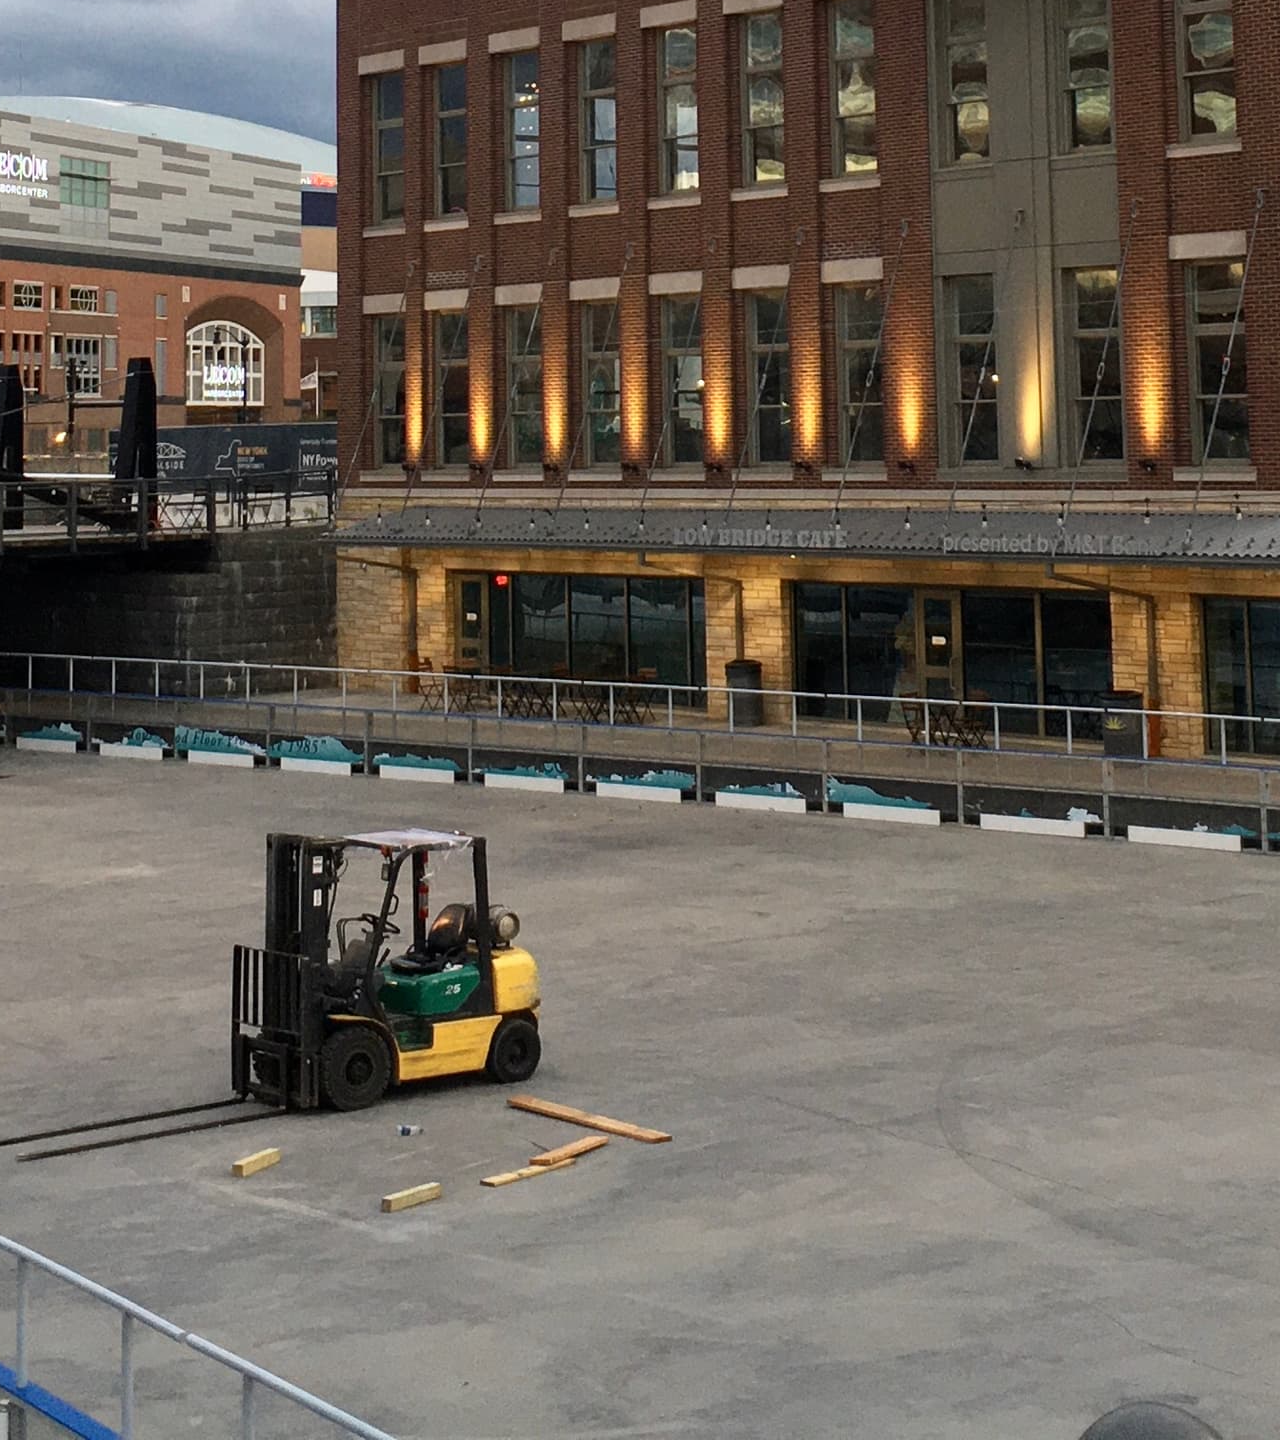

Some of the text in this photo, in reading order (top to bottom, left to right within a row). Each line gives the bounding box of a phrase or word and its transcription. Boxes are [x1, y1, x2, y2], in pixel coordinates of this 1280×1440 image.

[672, 528, 848, 548] LOW BRIDGE CAFE
[943, 533, 1033, 555] presented
[1037, 533, 1058, 558] by
[1064, 534, 1107, 555] M&T
[444, 983, 462, 996] 25
